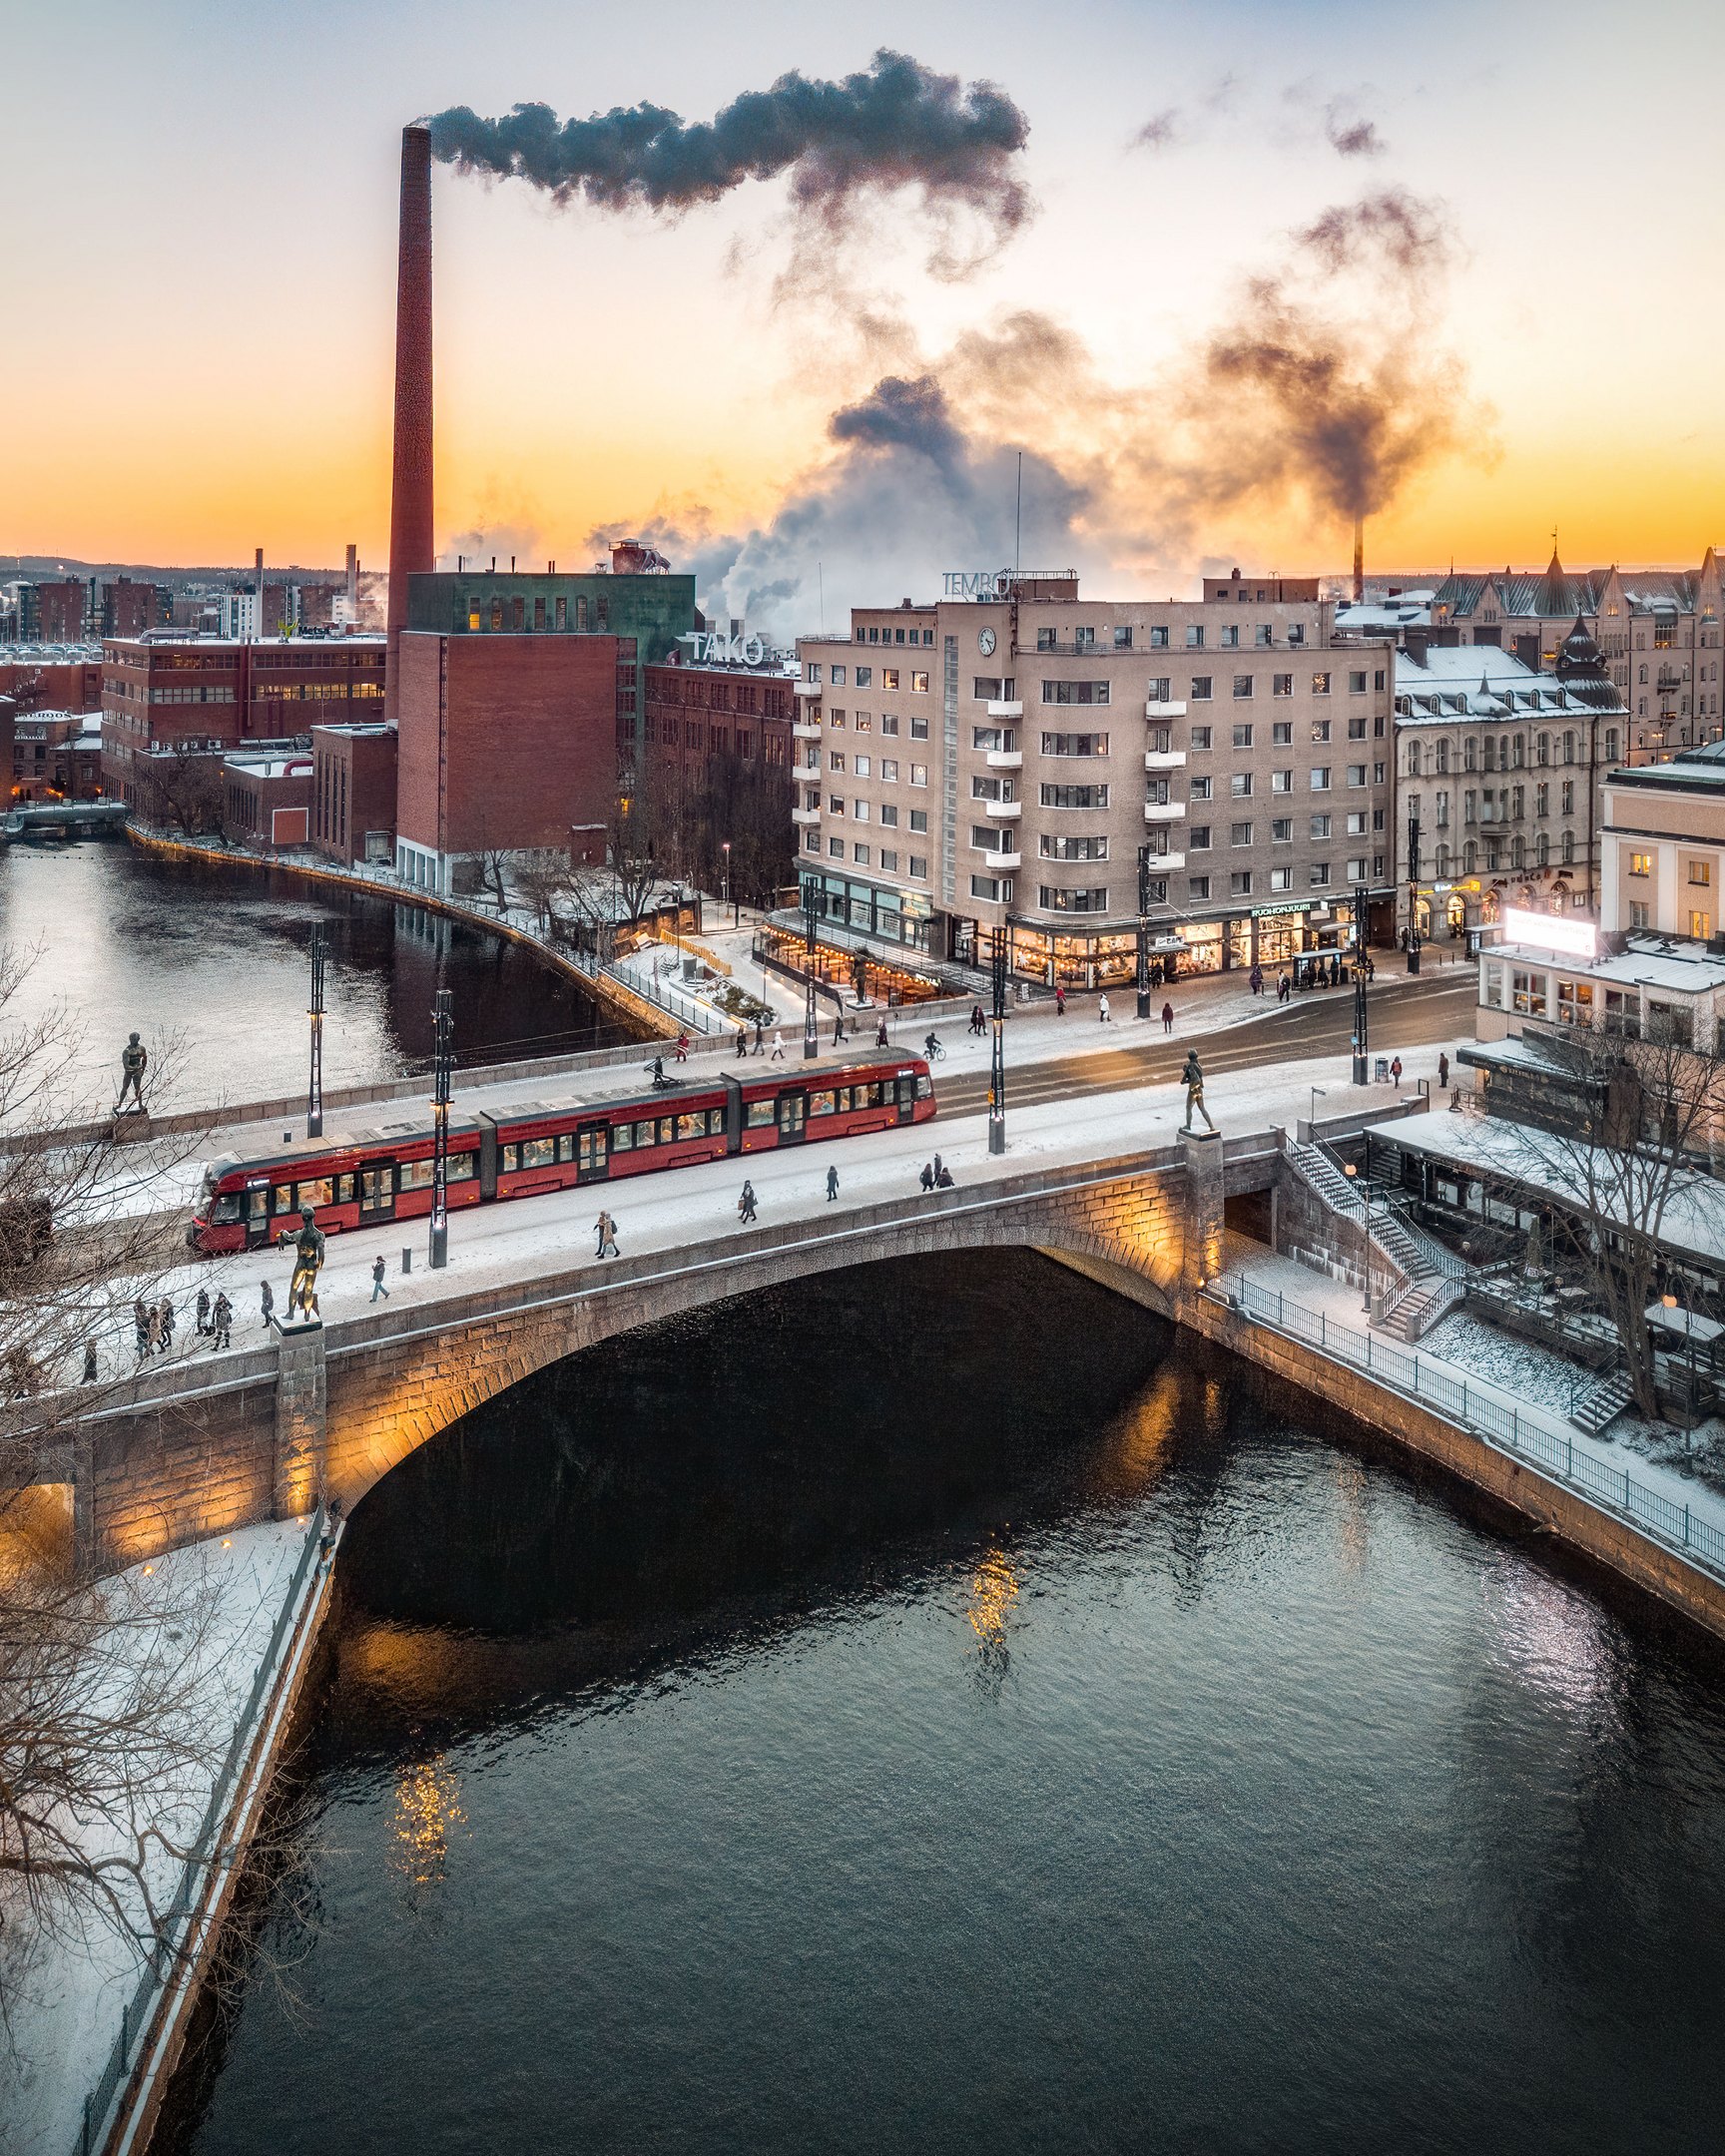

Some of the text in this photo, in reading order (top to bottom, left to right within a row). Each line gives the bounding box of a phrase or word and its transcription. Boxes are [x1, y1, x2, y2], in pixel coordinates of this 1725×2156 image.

[941, 572, 1010, 595] TEMPO
[686, 632, 764, 666] TAKO
[1251, 903, 1311, 917] RUOHONJUURI
